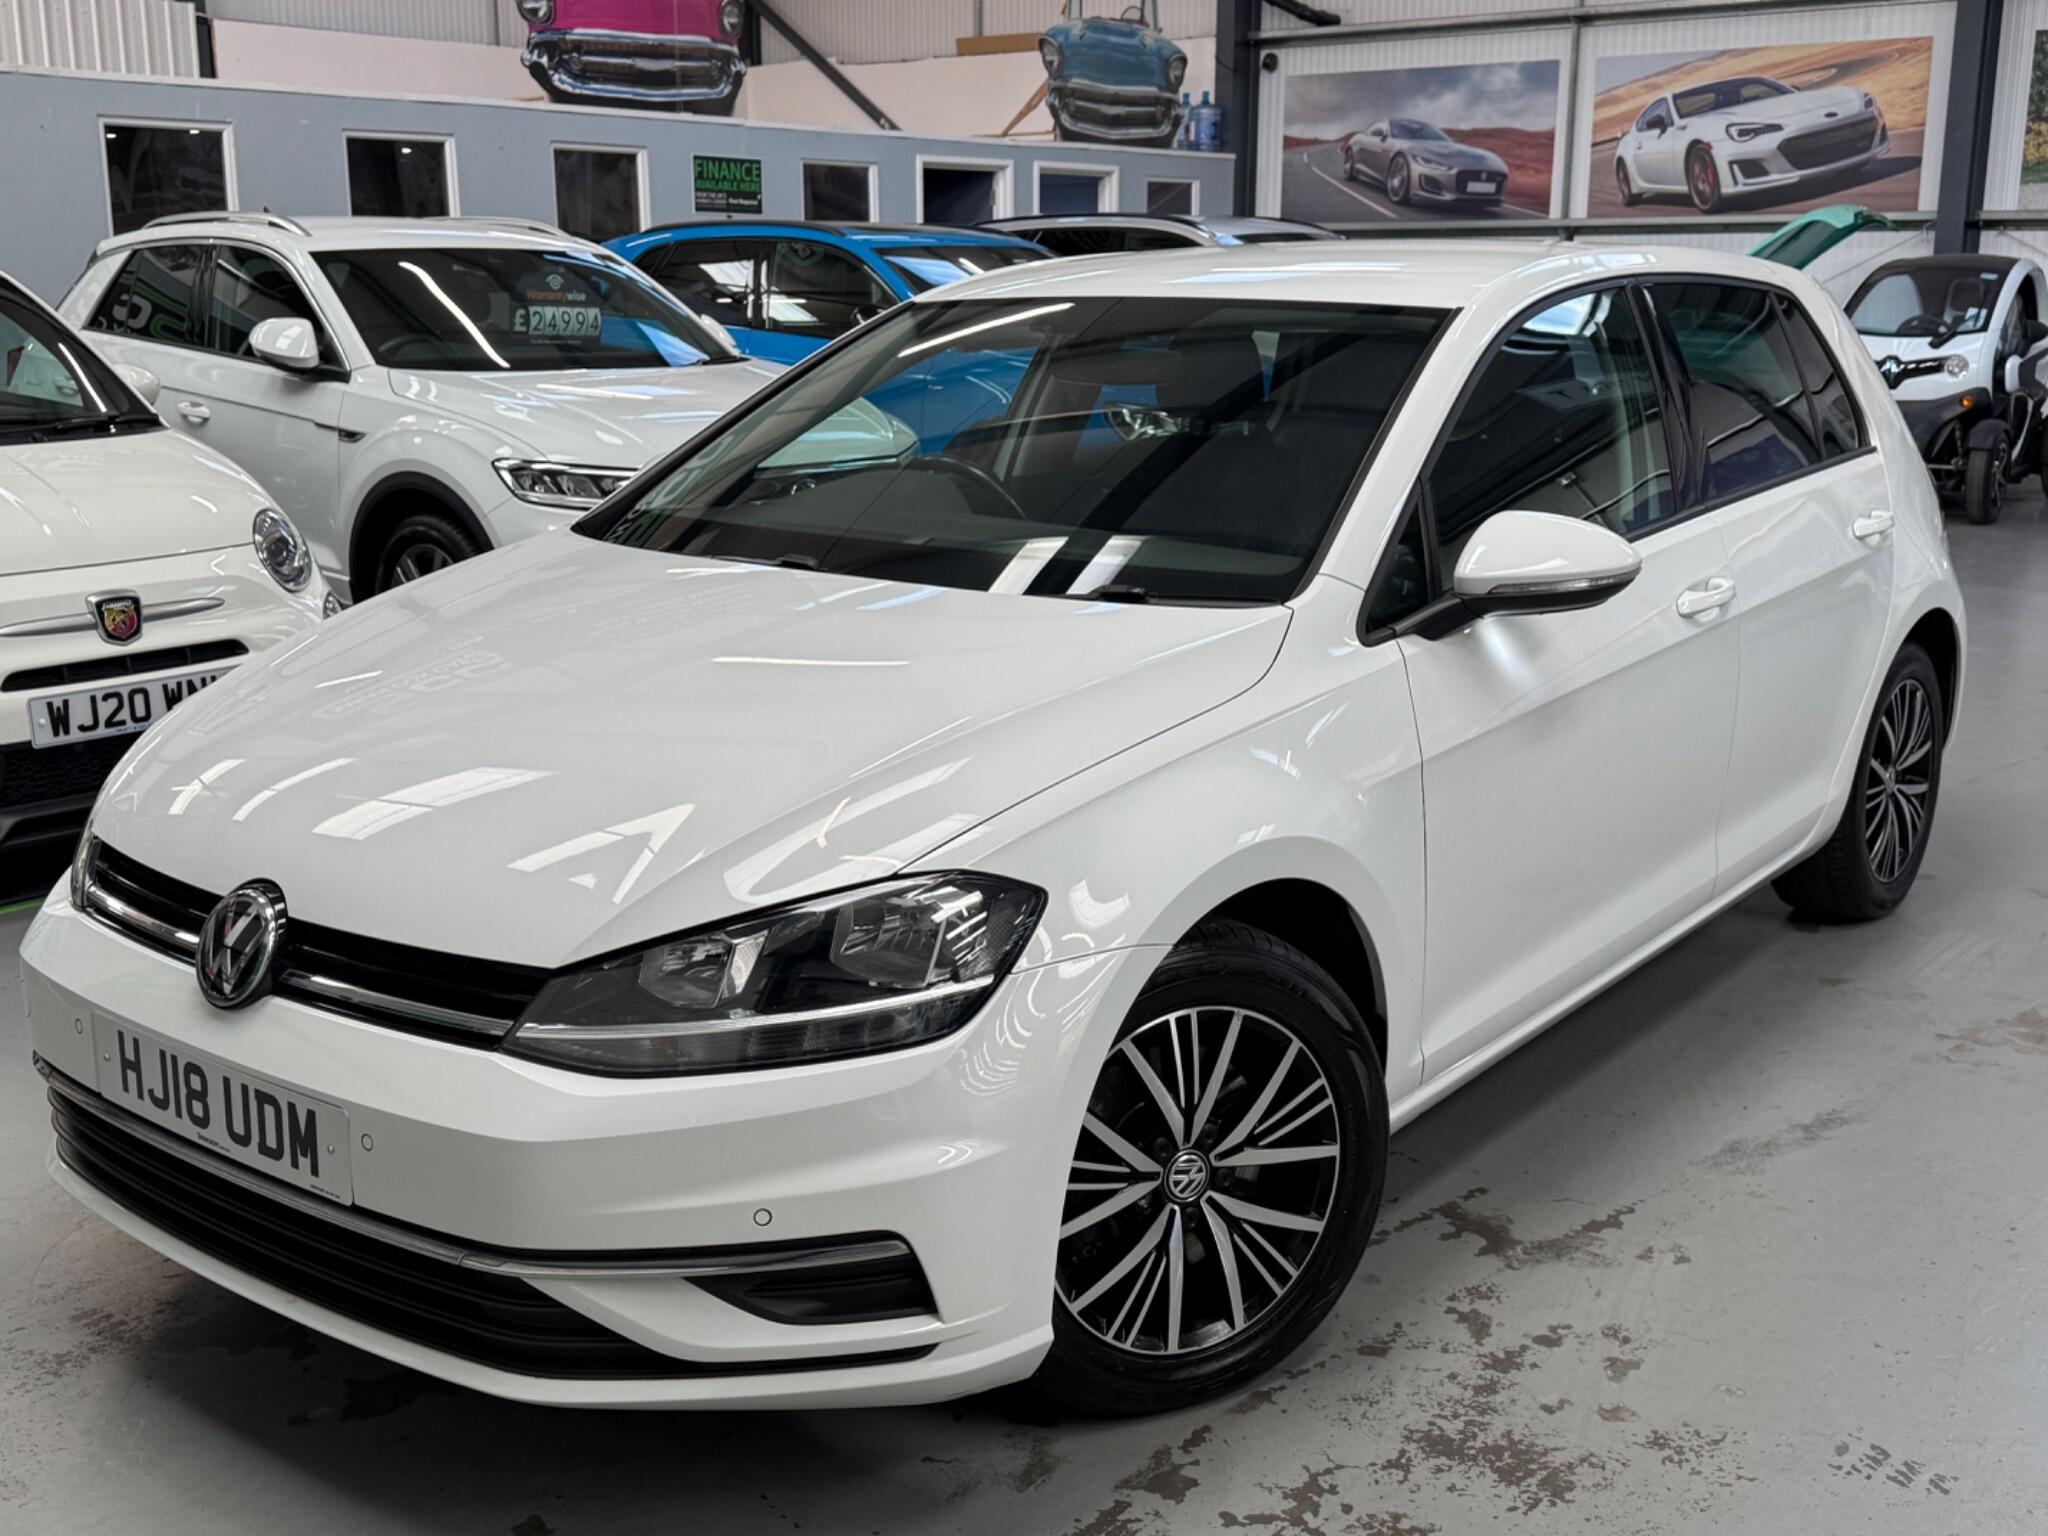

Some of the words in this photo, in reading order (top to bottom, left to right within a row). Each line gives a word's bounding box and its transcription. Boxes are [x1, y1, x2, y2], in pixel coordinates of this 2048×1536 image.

[695, 160, 761, 181] FINANCE
[695, 179, 738, 190] AVAILABLE
[740, 181, 761, 192] HERE
[528, 290, 586, 302] Warrantywise
[47, 687, 151, 737] WJ20
[118, 1030, 210, 1130] HJ18
[223, 1076, 319, 1178] UDM
